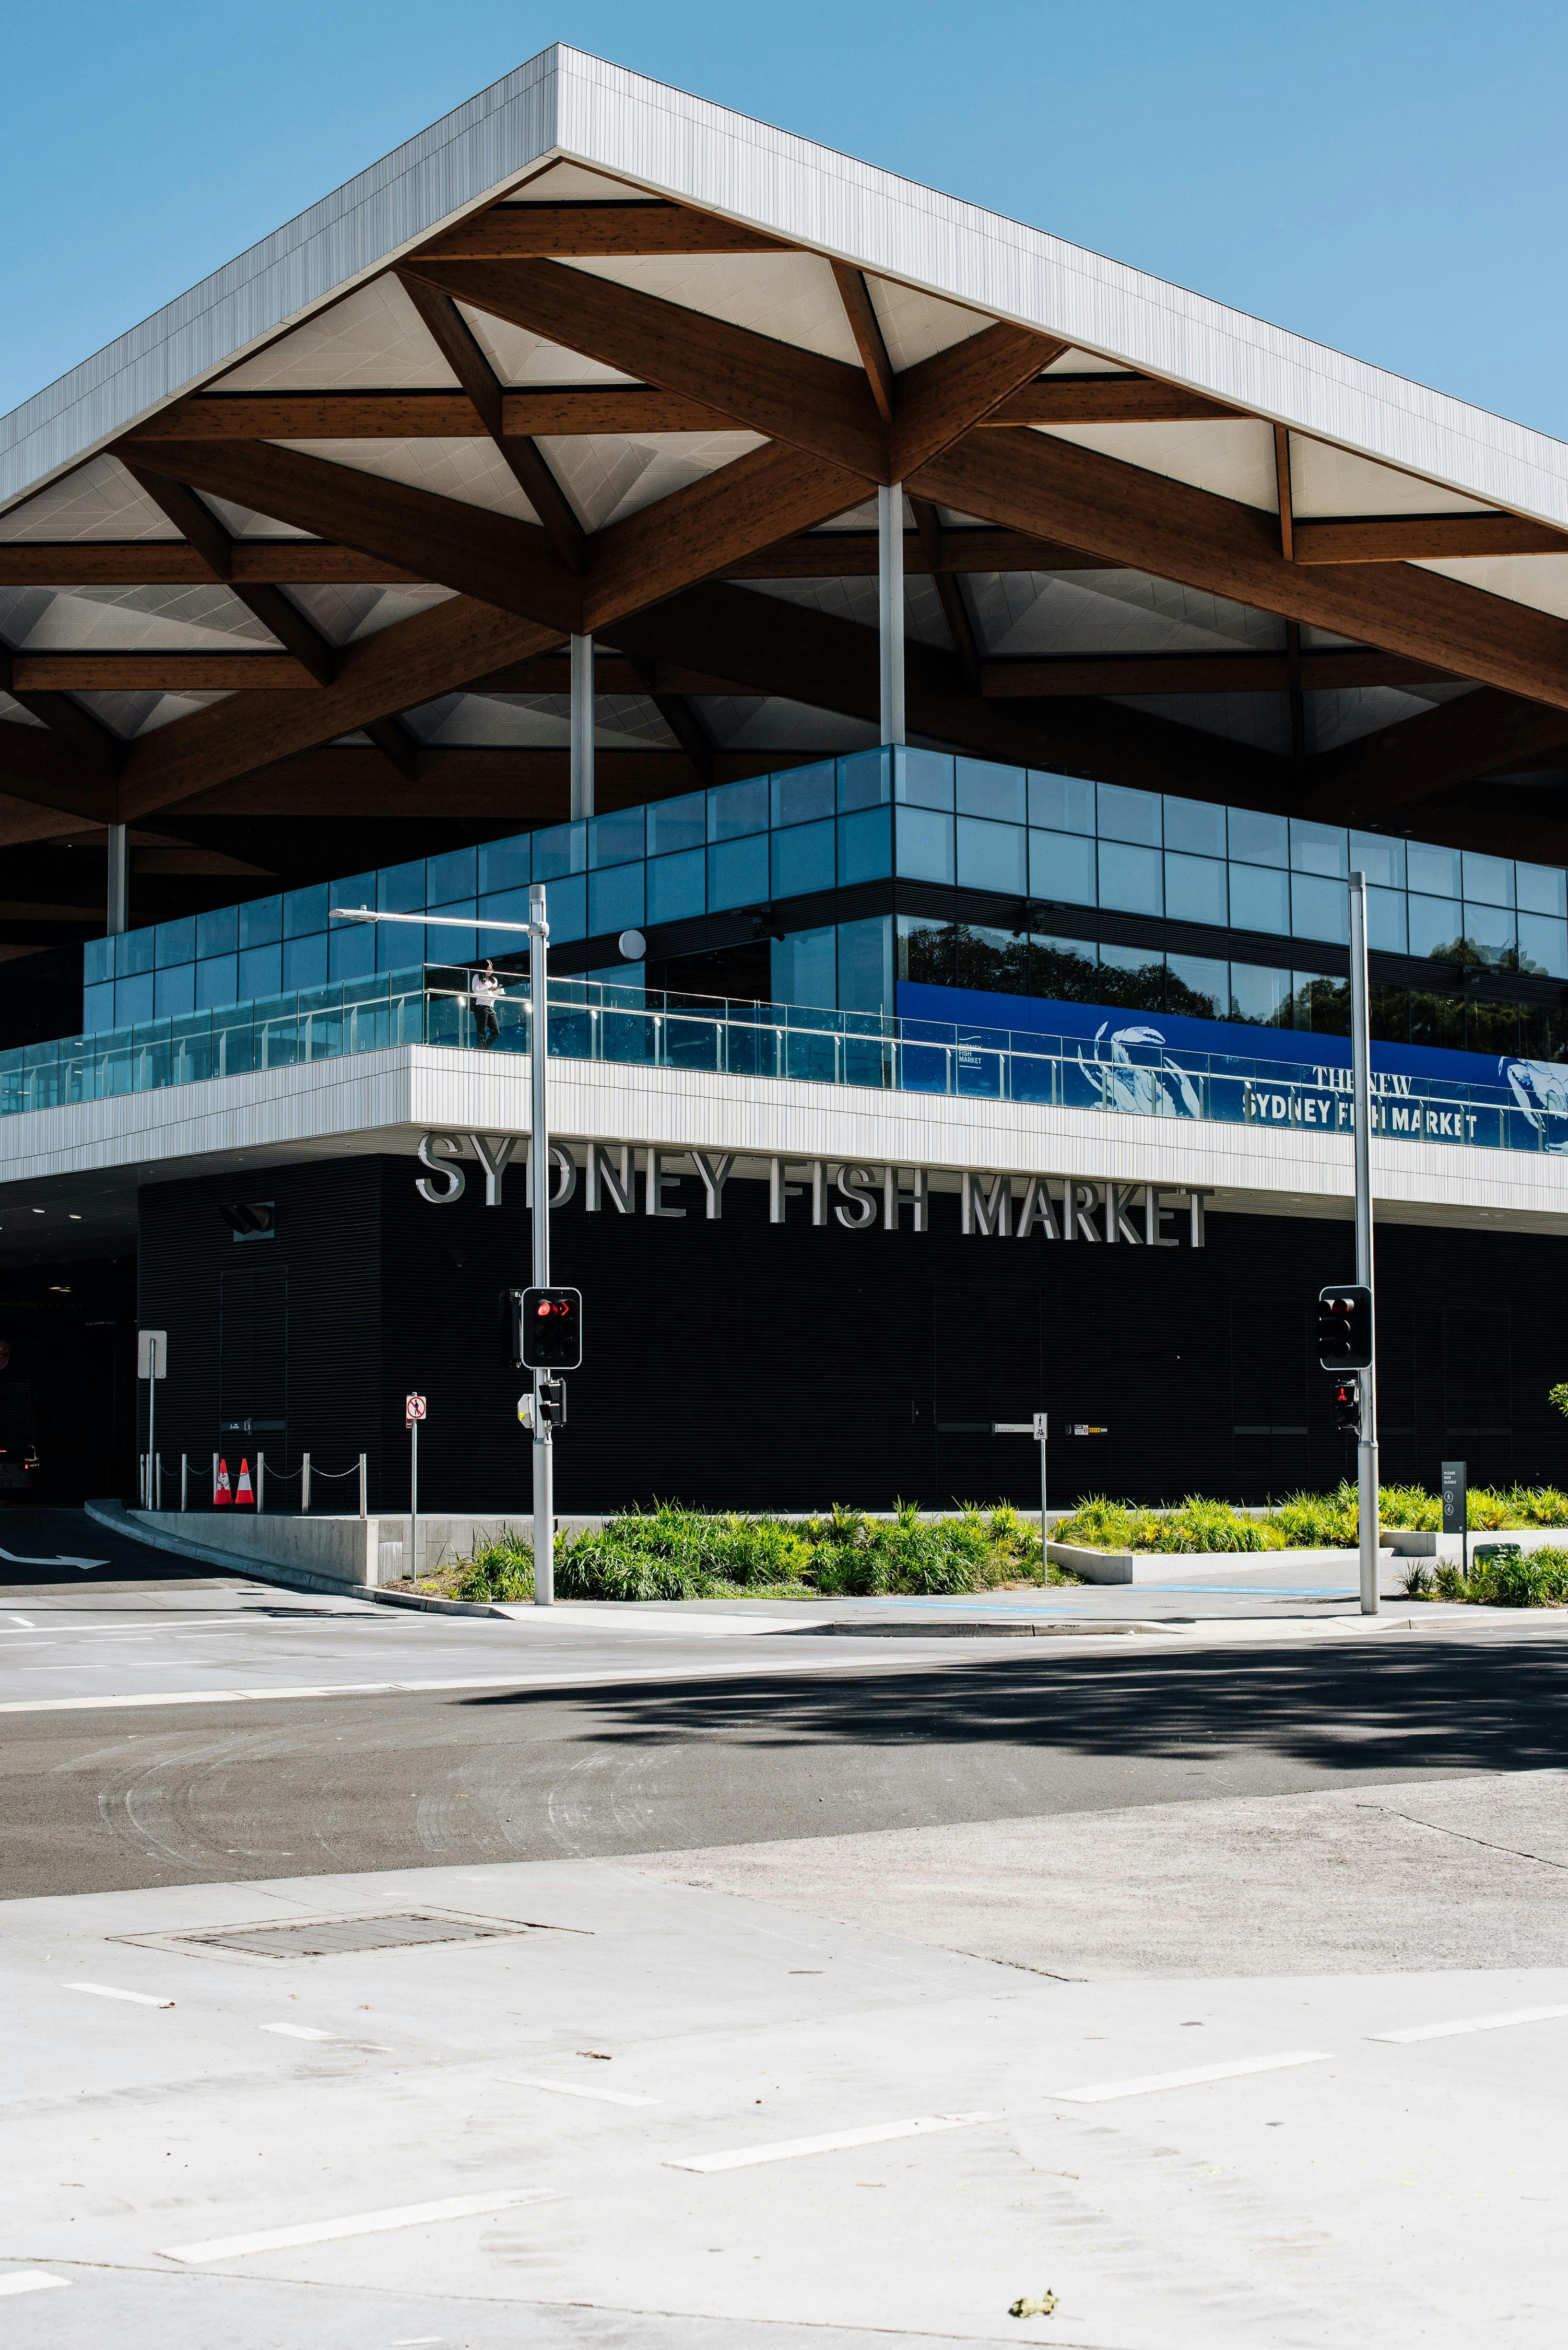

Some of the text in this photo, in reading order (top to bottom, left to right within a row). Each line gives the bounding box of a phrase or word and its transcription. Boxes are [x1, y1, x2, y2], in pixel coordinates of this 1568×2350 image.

[1242, 1092, 1477, 1137] SYDNEY FIH MARKET
[415, 1131, 1215, 1248] SYDNEY FISH MARKET
